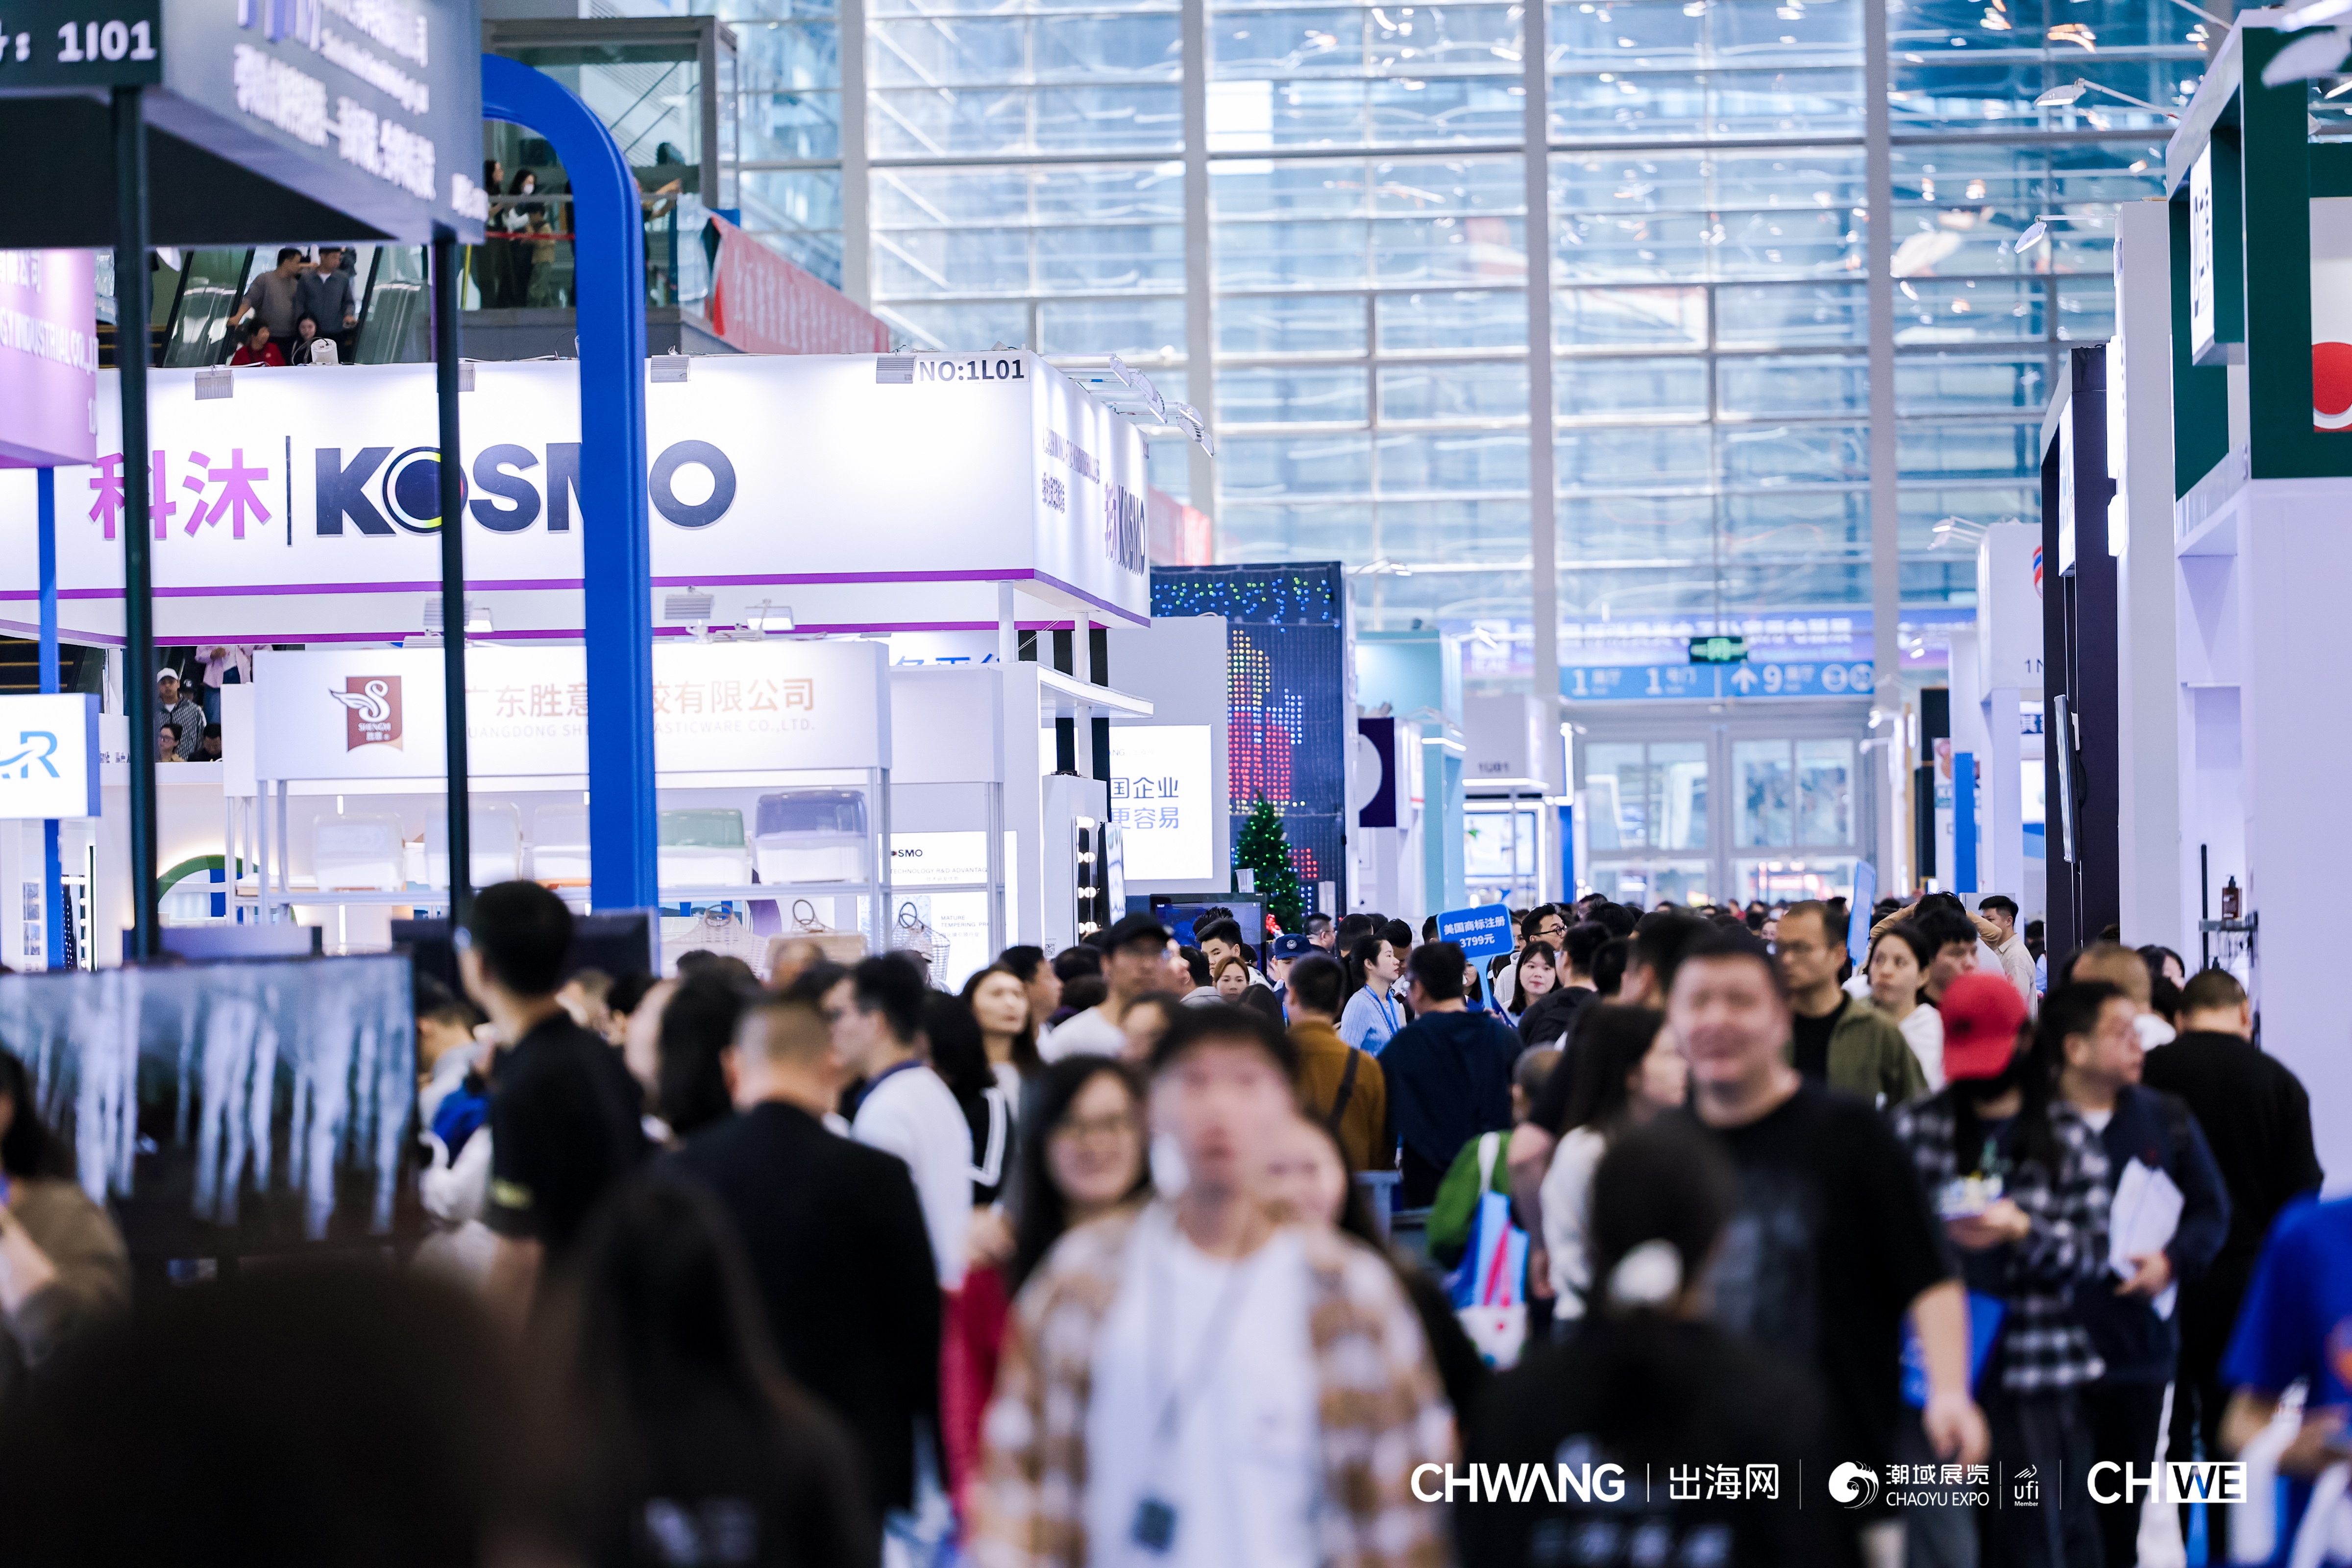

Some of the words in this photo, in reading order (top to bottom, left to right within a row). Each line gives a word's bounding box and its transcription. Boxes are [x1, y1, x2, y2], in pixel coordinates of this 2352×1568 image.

[1118, 484, 1146, 577] KOSMO
[466, 724, 556, 738] UANGDONG
[1444, 915, 1506, 935] 美国商标注册
[1460, 933, 1495, 948] 3799元
